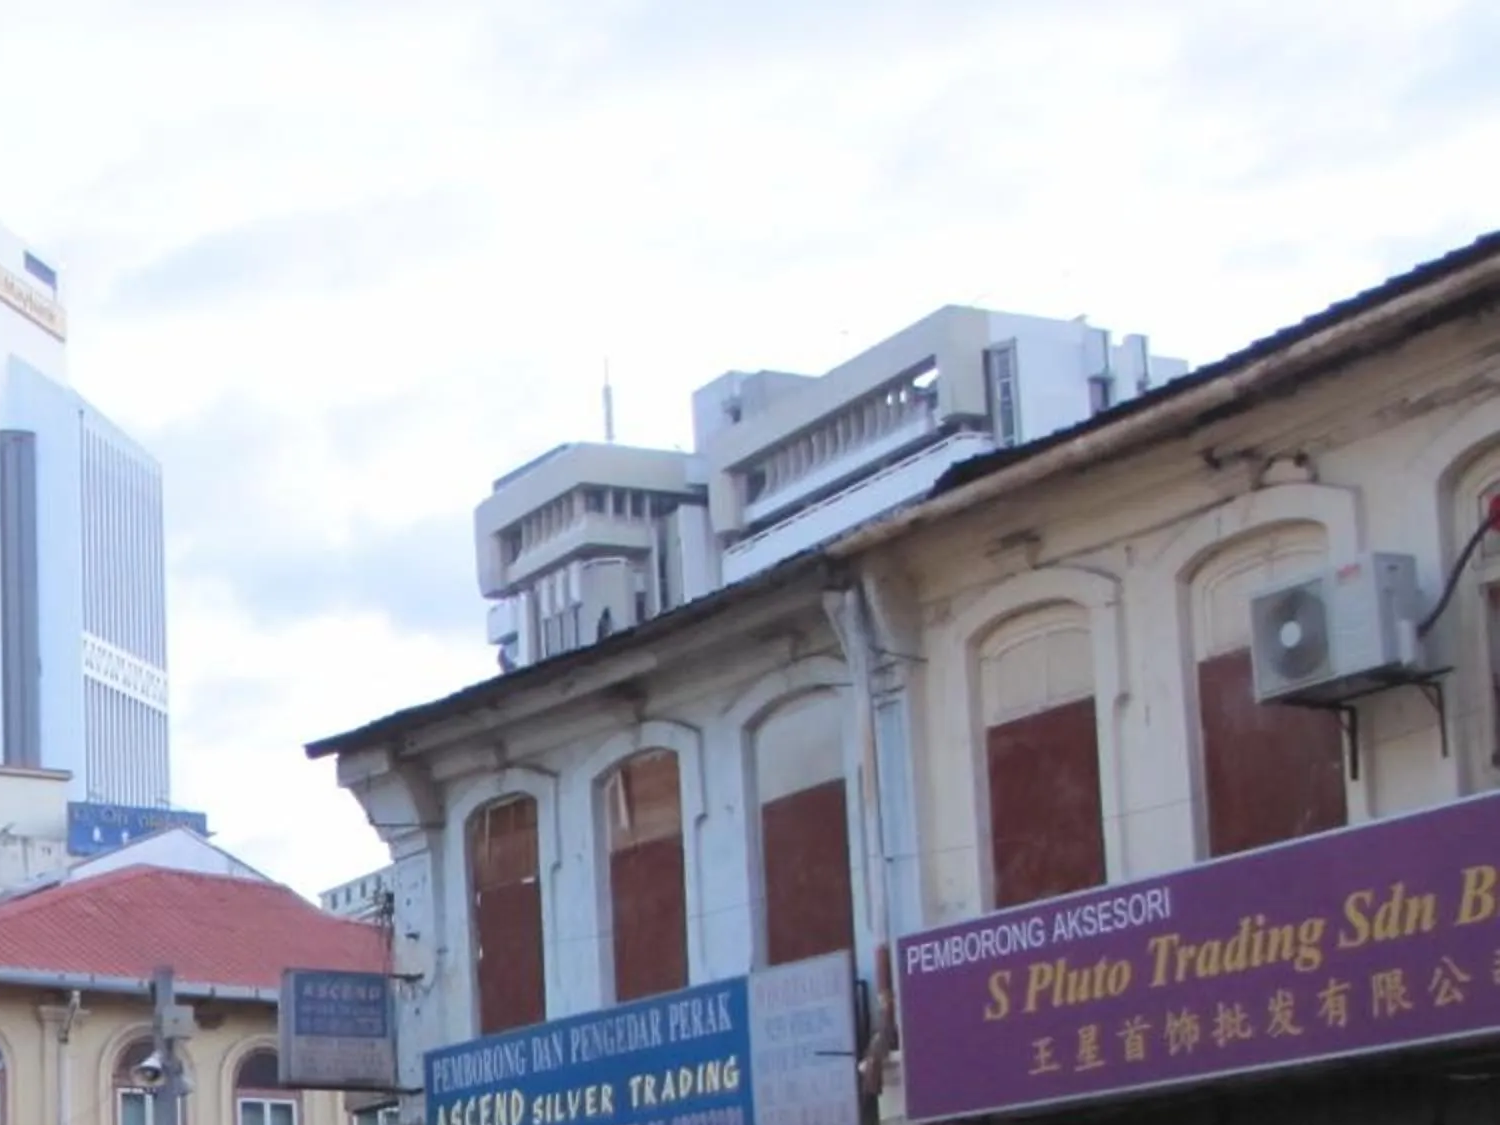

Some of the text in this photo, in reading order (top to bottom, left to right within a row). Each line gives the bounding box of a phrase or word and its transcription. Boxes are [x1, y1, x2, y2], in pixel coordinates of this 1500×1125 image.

[906, 887, 1171, 975] PEMBORONG AKSESORI
[983, 968, 1013, 1022] S
[1023, 953, 1132, 1014] Pluto
[1147, 912, 1326, 988] Trading
[1338, 881, 1437, 950] Sdn
[431, 1037, 529, 1095] PEMBORONG
[531, 1034, 564, 1075] DAN
[570, 1010, 662, 1062] PENGEDAR
[668, 991, 733, 1042] PERAK
[628, 1054, 741, 1108] TRADING
